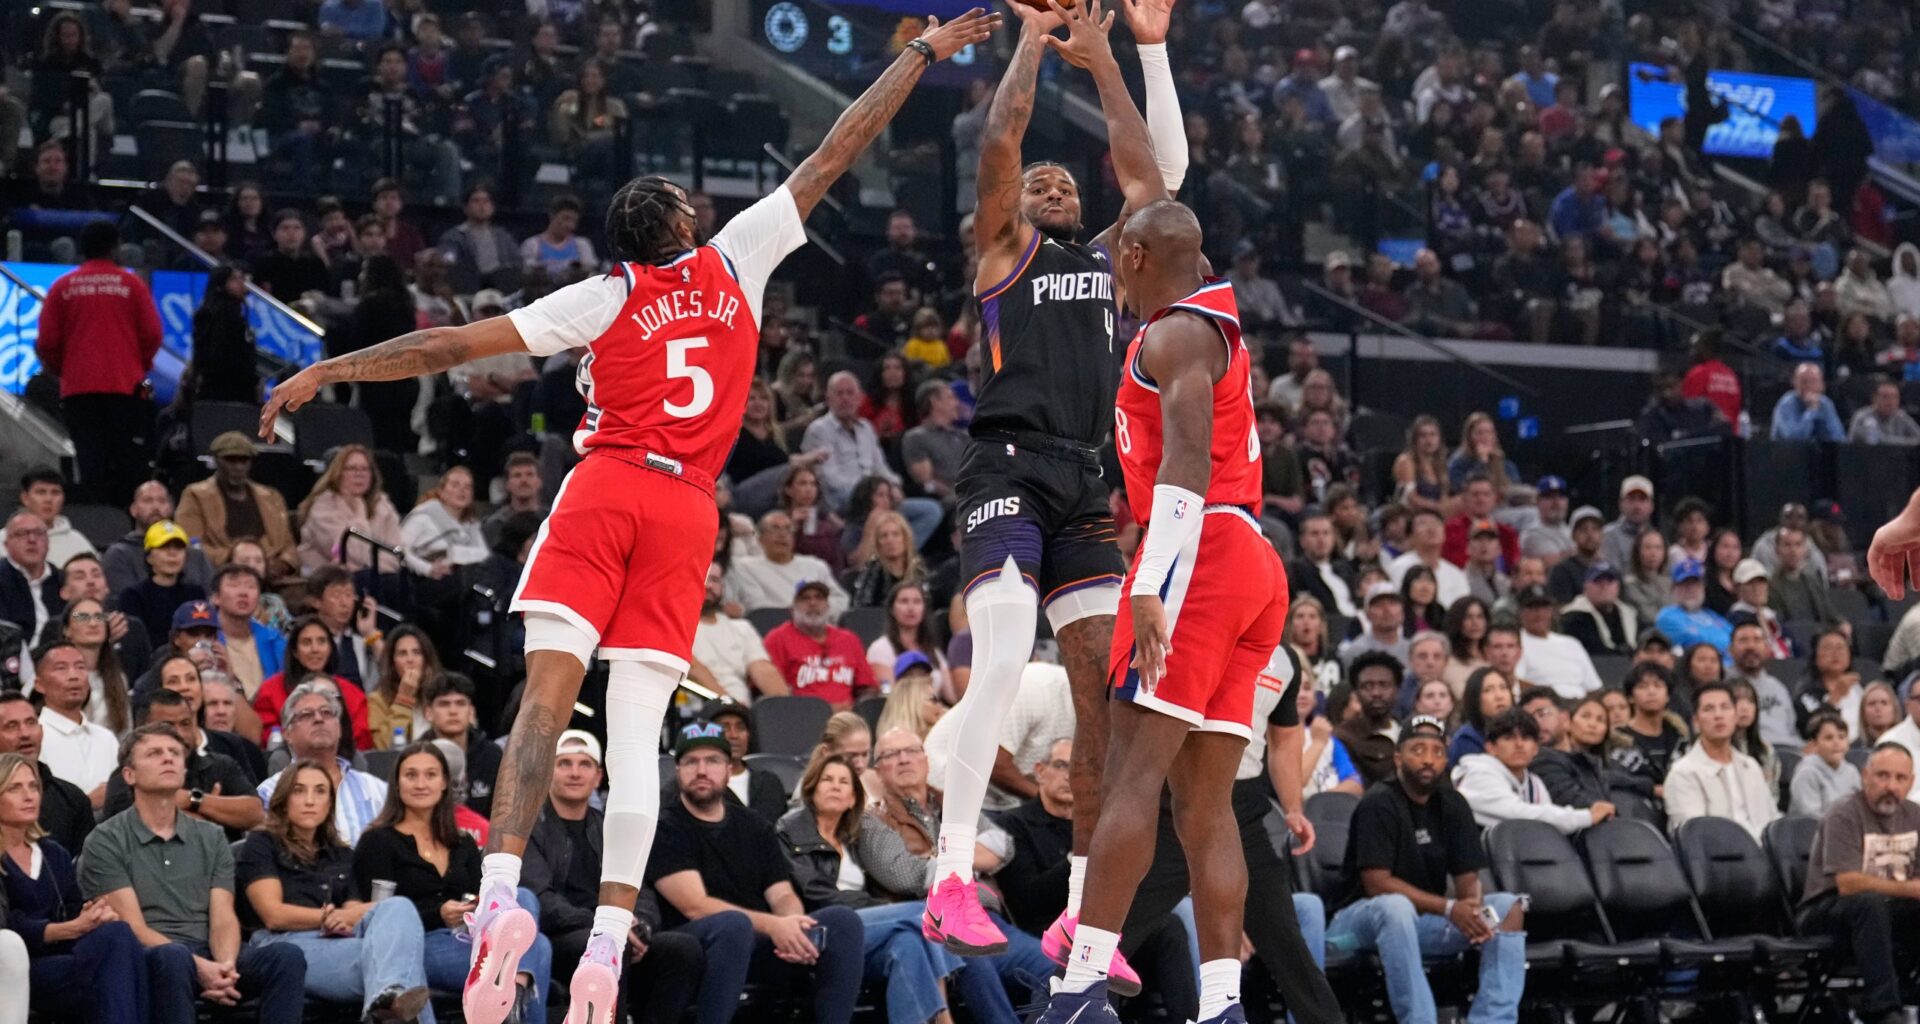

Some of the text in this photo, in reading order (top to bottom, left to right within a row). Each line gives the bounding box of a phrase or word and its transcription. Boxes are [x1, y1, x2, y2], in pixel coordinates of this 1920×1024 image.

[827, 14, 852, 55] 3
[631, 290, 740, 341] JONES JR.
[1103, 307, 1114, 354] 4
[663, 336, 715, 419] 5
[1114, 406, 1132, 455] 8
[967, 496, 1021, 534] SUNS
